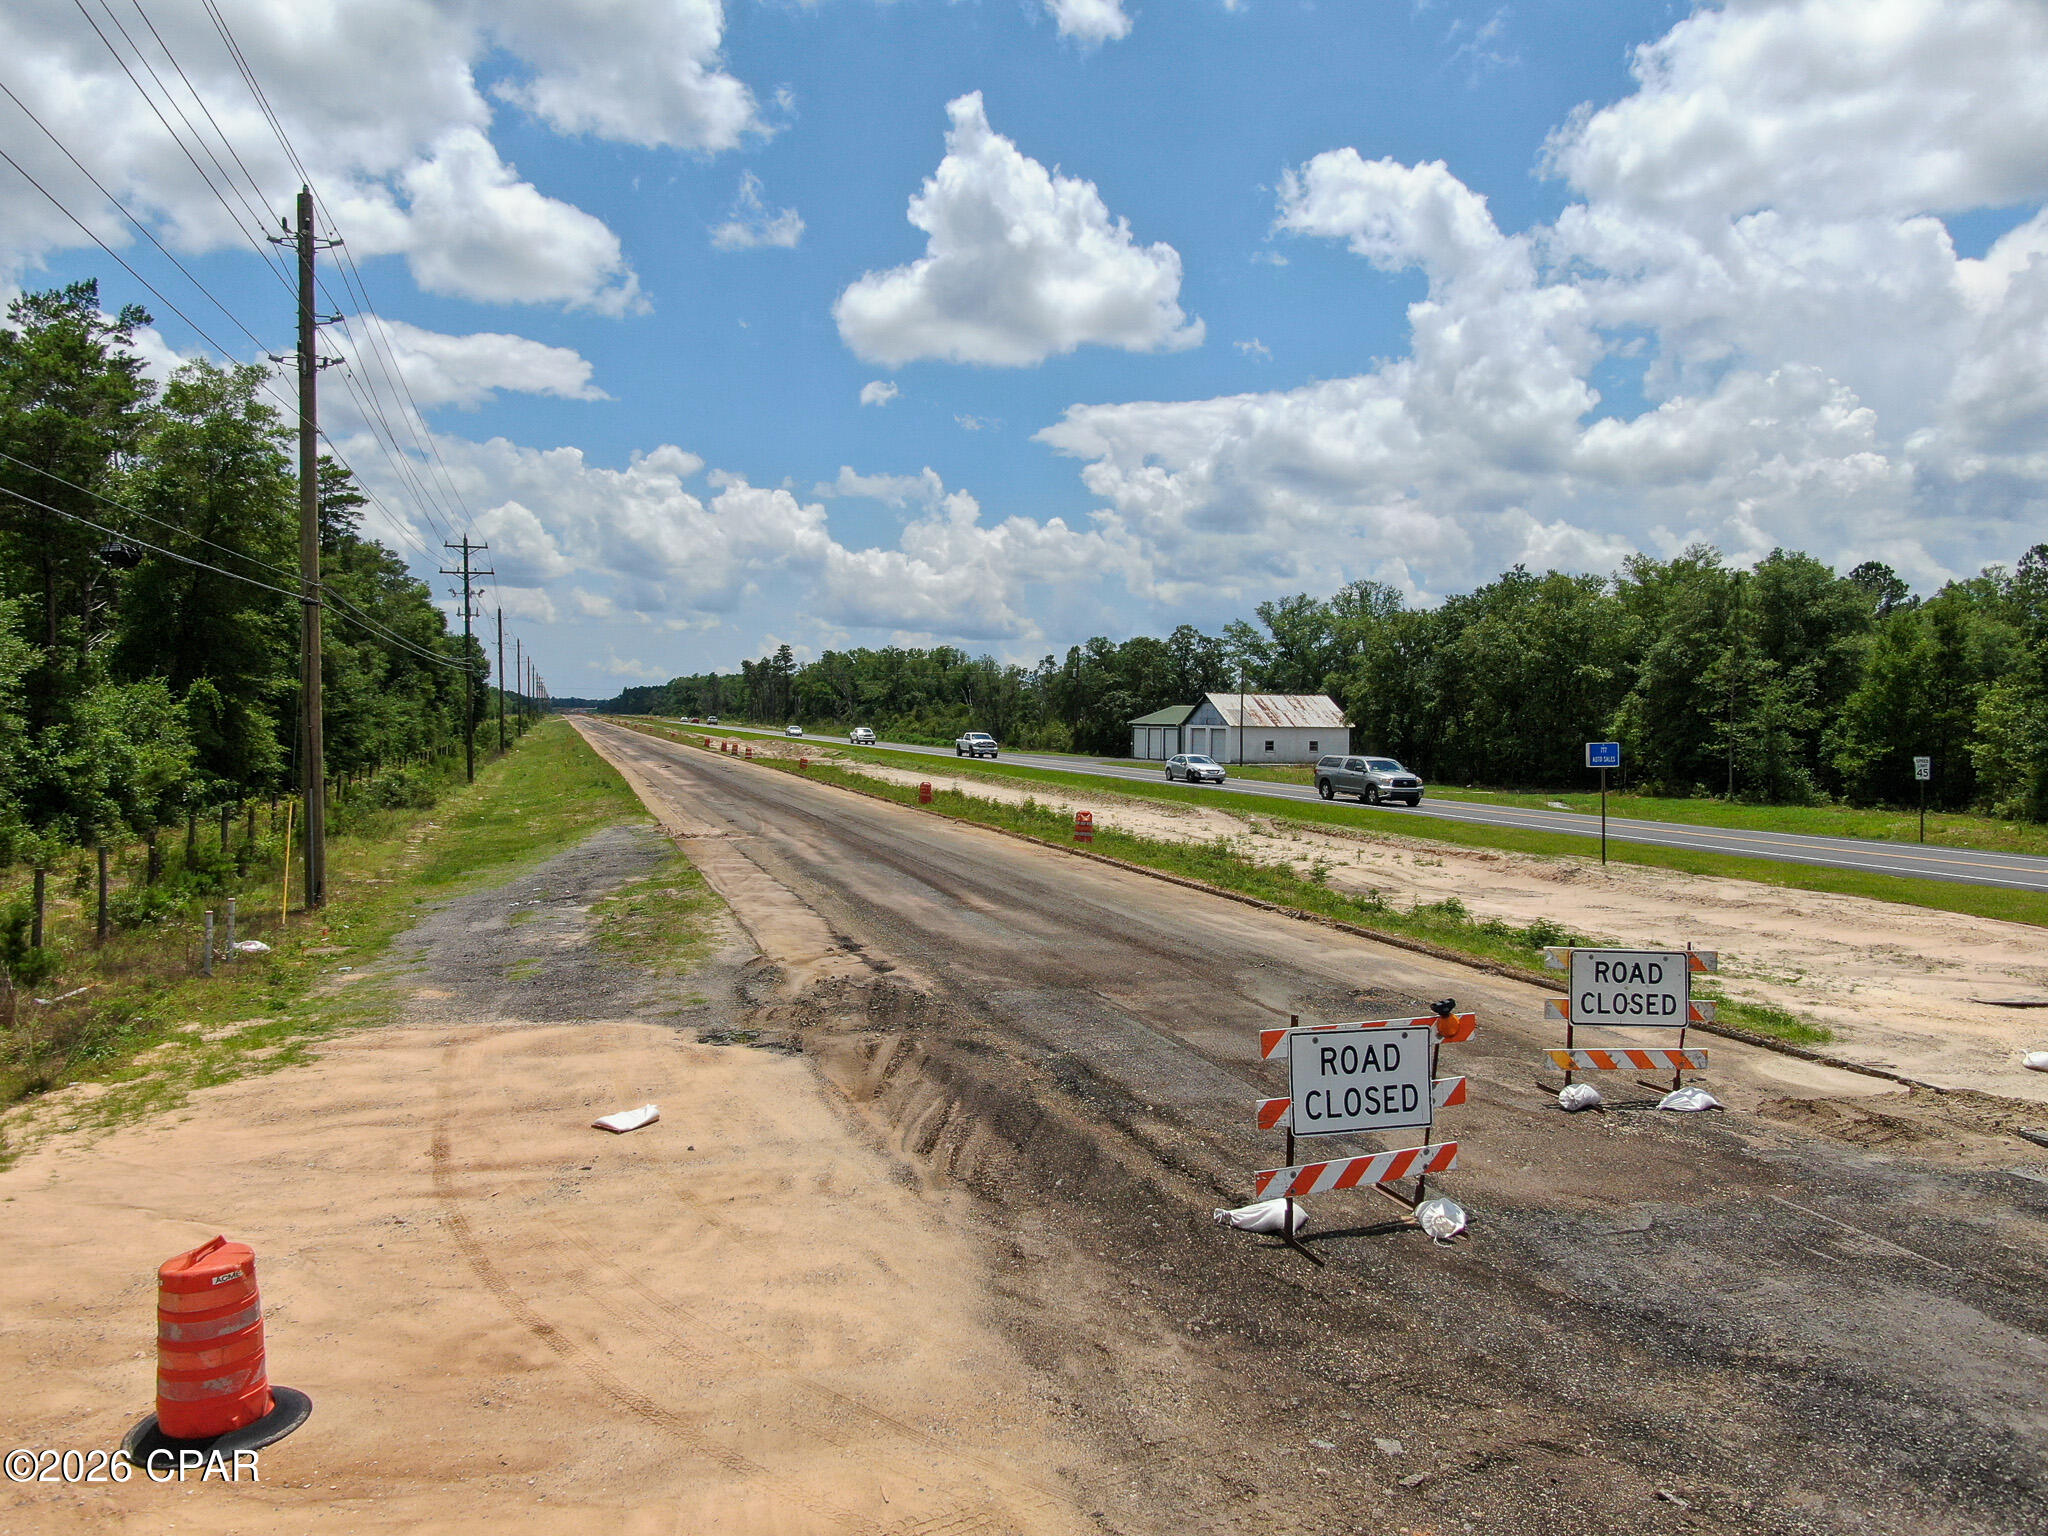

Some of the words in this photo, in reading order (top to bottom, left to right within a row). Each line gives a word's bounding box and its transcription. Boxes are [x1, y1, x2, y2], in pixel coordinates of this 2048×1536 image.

[1916, 768, 1929, 777] 45
[1594, 961, 1663, 985] ROAD
[1581, 992, 1677, 1016] CLOSED
[1320, 1043, 1401, 1076] ROAD
[1305, 1083, 1419, 1120] CLOSED
[215, 1270, 243, 1284] ACME
